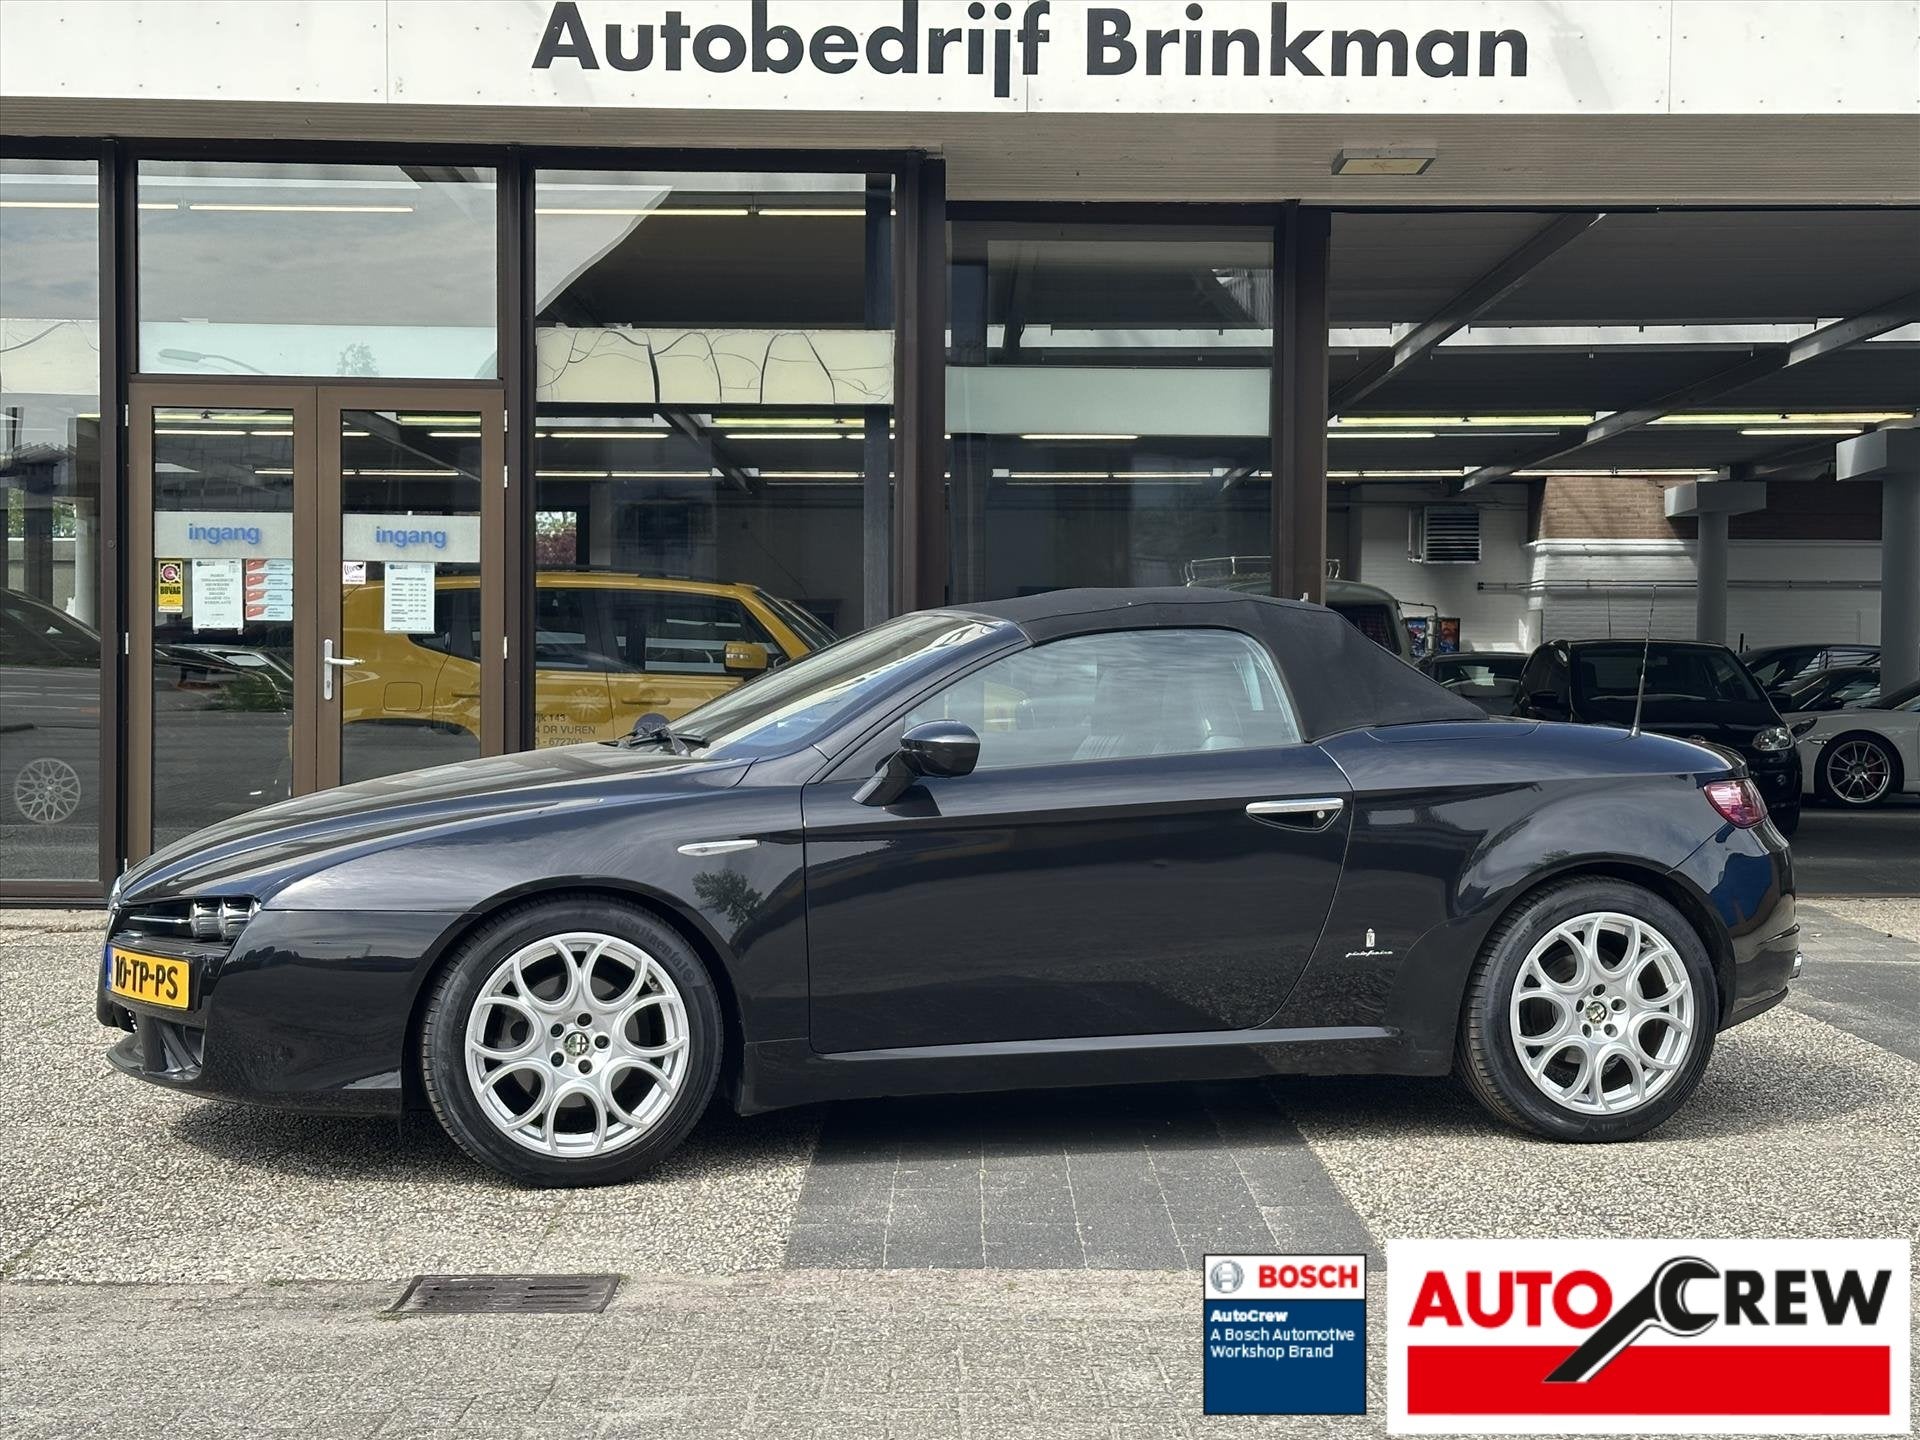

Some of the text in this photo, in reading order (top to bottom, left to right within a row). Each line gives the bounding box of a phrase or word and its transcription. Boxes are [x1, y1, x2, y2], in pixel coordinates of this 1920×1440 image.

[531, 0, 1528, 98] Autobedrijf Brinkman
[188, 523, 261, 545] ingang
[375, 526, 447, 548] ingang
[160, 586, 181, 595] BOVAG
[543, 725, 557, 734] DR
[560, 725, 596, 735] VUREN
[114, 955, 178, 1000] 10-TP-PS
